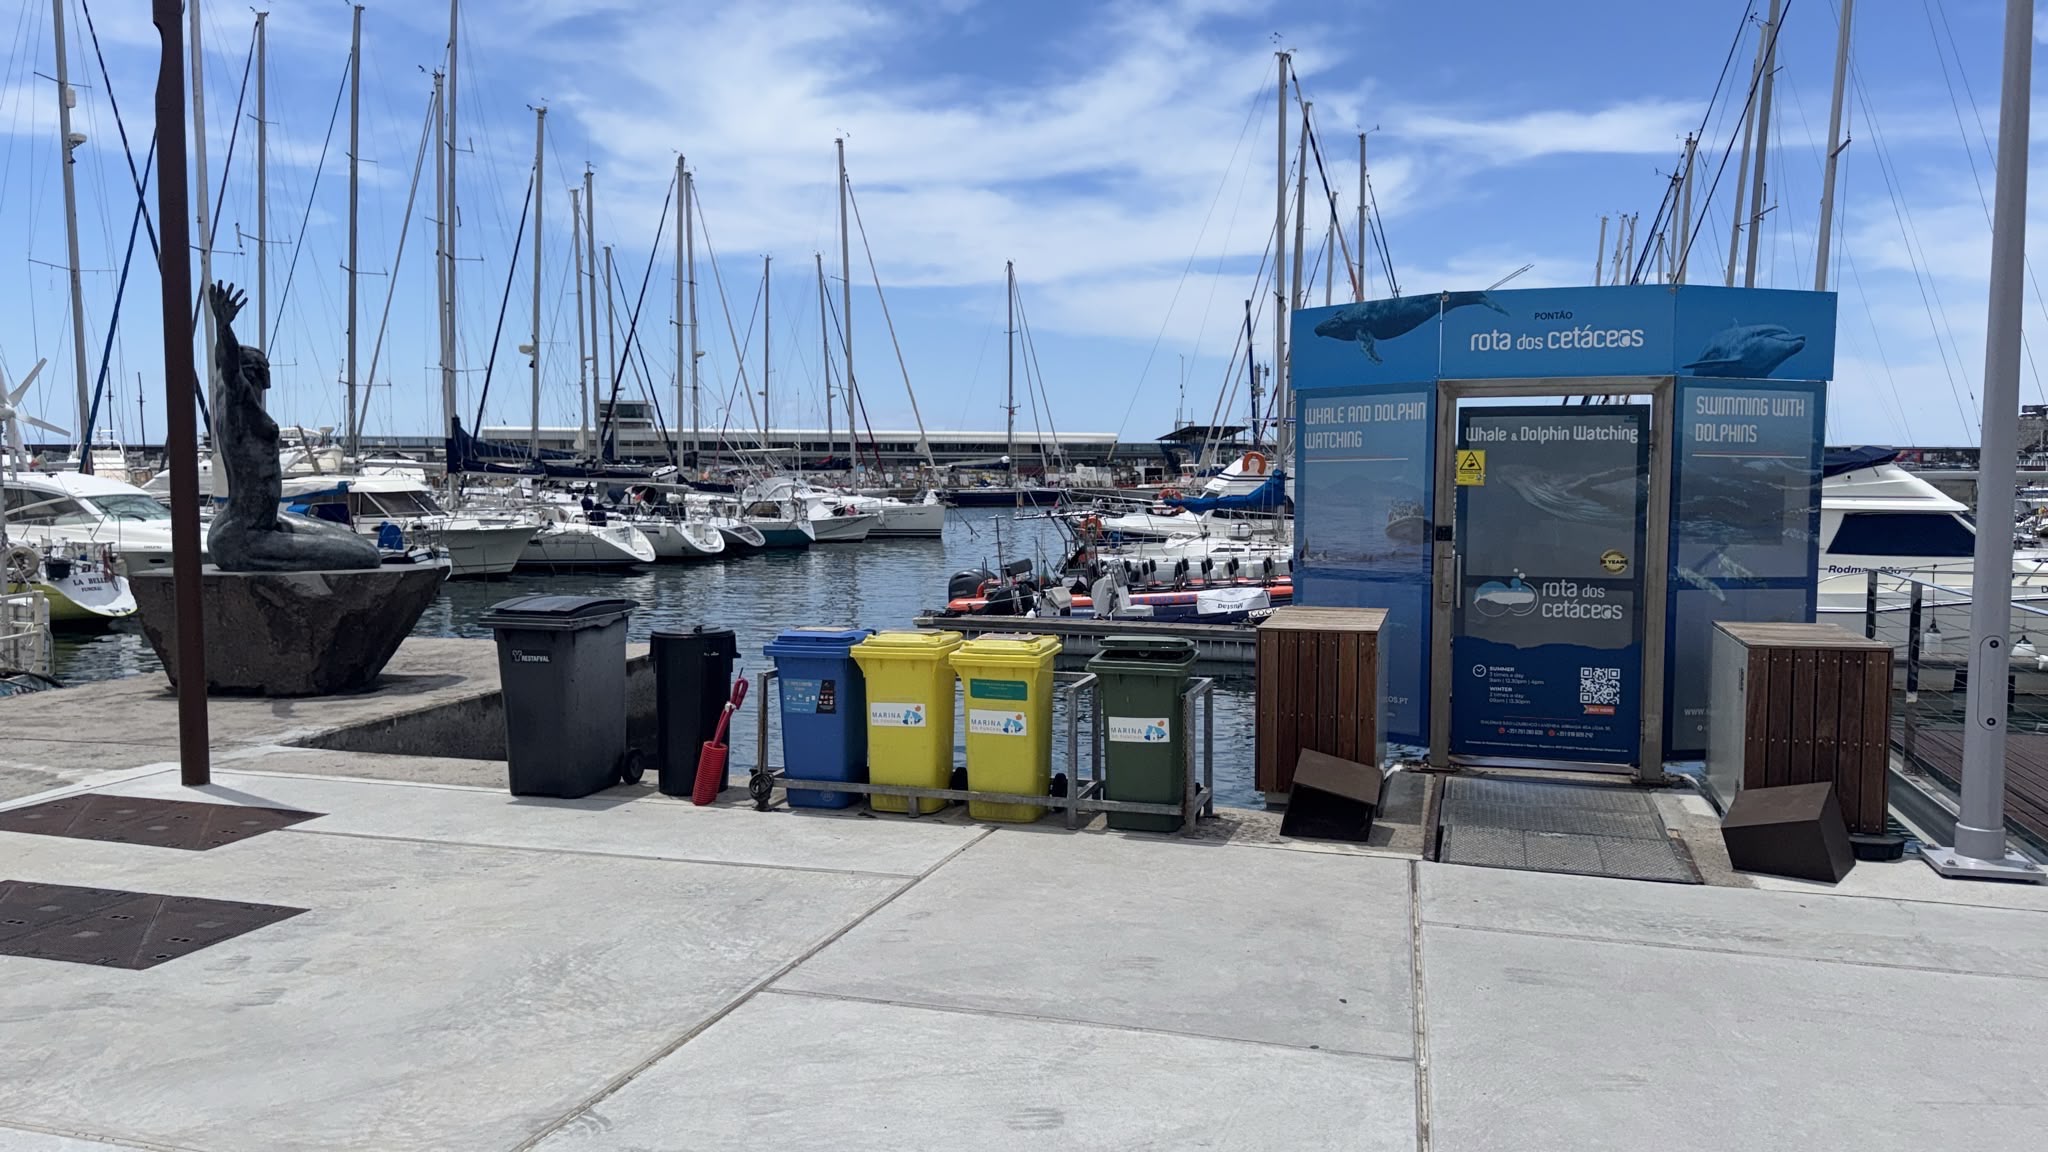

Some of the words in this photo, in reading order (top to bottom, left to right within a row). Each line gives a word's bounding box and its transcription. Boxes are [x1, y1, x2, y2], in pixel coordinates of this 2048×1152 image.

[1534, 311, 1573, 320] PONTÃO
[1470, 329, 1511, 351] rota
[1516, 334, 1543, 350] dos
[1547, 324, 1644, 350] cetáceos
[1305, 406, 1345, 425] WHALE
[1348, 405, 1371, 423] AND
[1374, 402, 1426, 421] DOLPHIN
[1696, 396, 1768, 416] SWIMMING
[1772, 398, 1804, 416] WITH
[1304, 431, 1362, 449] WATCHING
[1465, 427, 1507, 442] Whale
[1520, 426, 1569, 444] Dolphin
[1573, 425, 1639, 444] Watching
[1695, 423, 1757, 443] DOLPHINS
[1828, 565, 1872, 574] Rodma
[1542, 579, 1578, 597] rota
[1582, 584, 1605, 598] dos
[1542, 599, 1623, 619] cetáceos
[872, 711, 901, 719] MARINA
